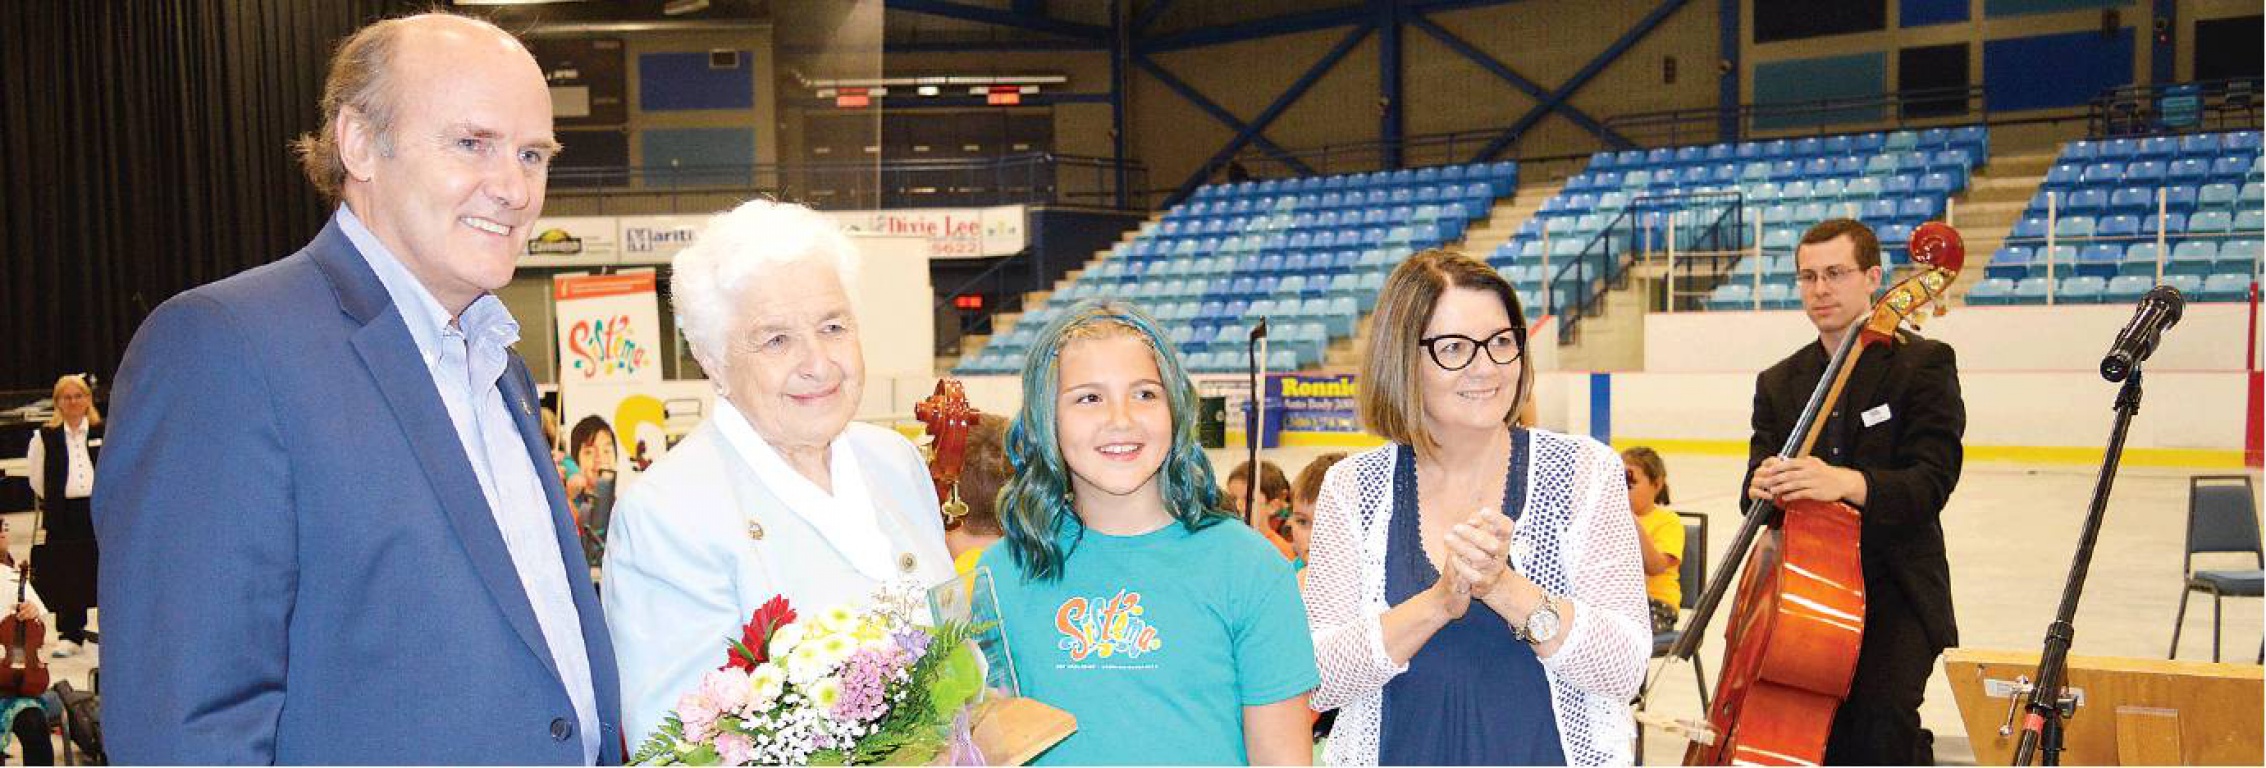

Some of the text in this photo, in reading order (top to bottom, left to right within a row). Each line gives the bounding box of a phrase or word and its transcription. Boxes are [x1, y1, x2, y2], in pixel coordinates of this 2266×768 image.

[887, 214, 937, 236] Dixie
[945, 213, 979, 237] Lee
[1055, 588, 1158, 661] Sistema
